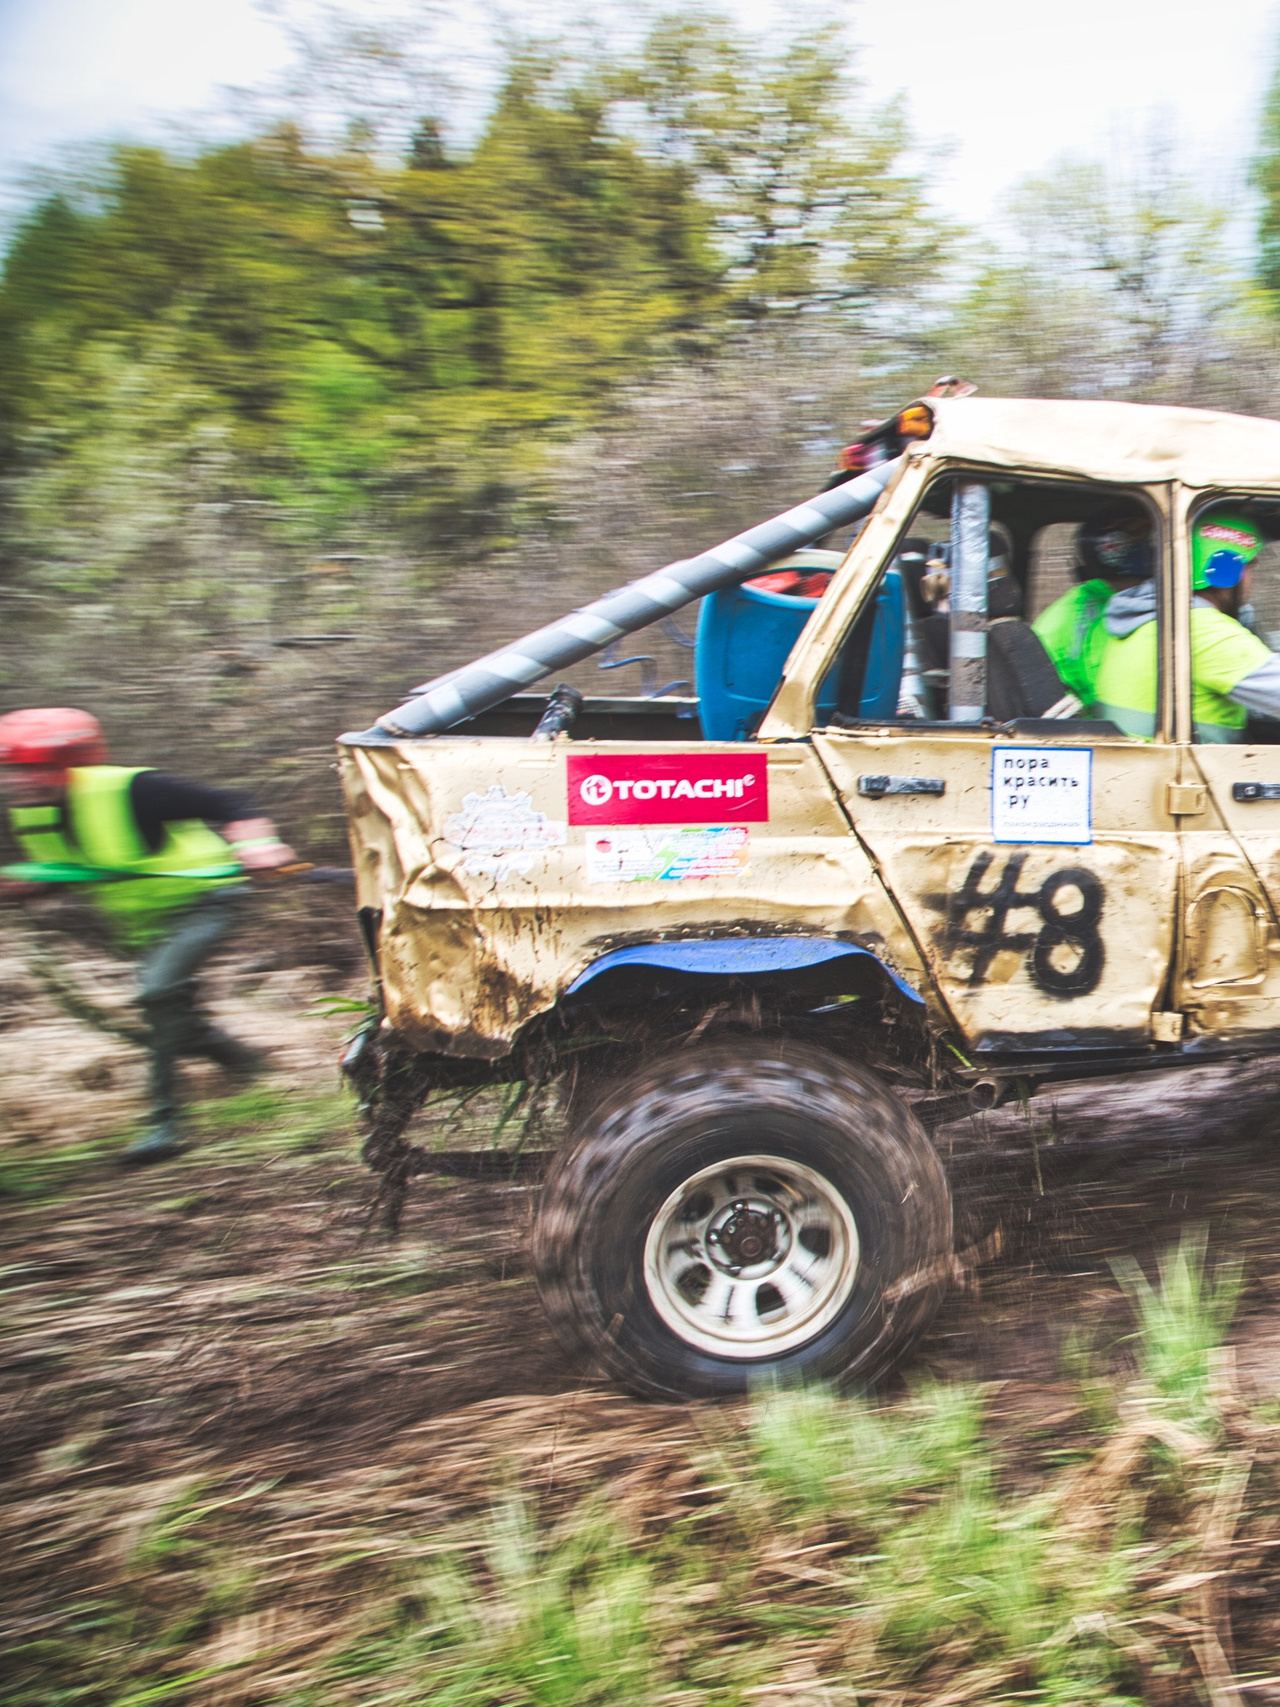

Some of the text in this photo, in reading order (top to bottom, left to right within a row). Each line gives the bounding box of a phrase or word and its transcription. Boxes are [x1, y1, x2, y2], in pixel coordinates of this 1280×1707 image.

[1003, 757, 1050, 772] пора
[613, 778, 744, 800] TOTACHI
[1003, 775, 1079, 790] красить
